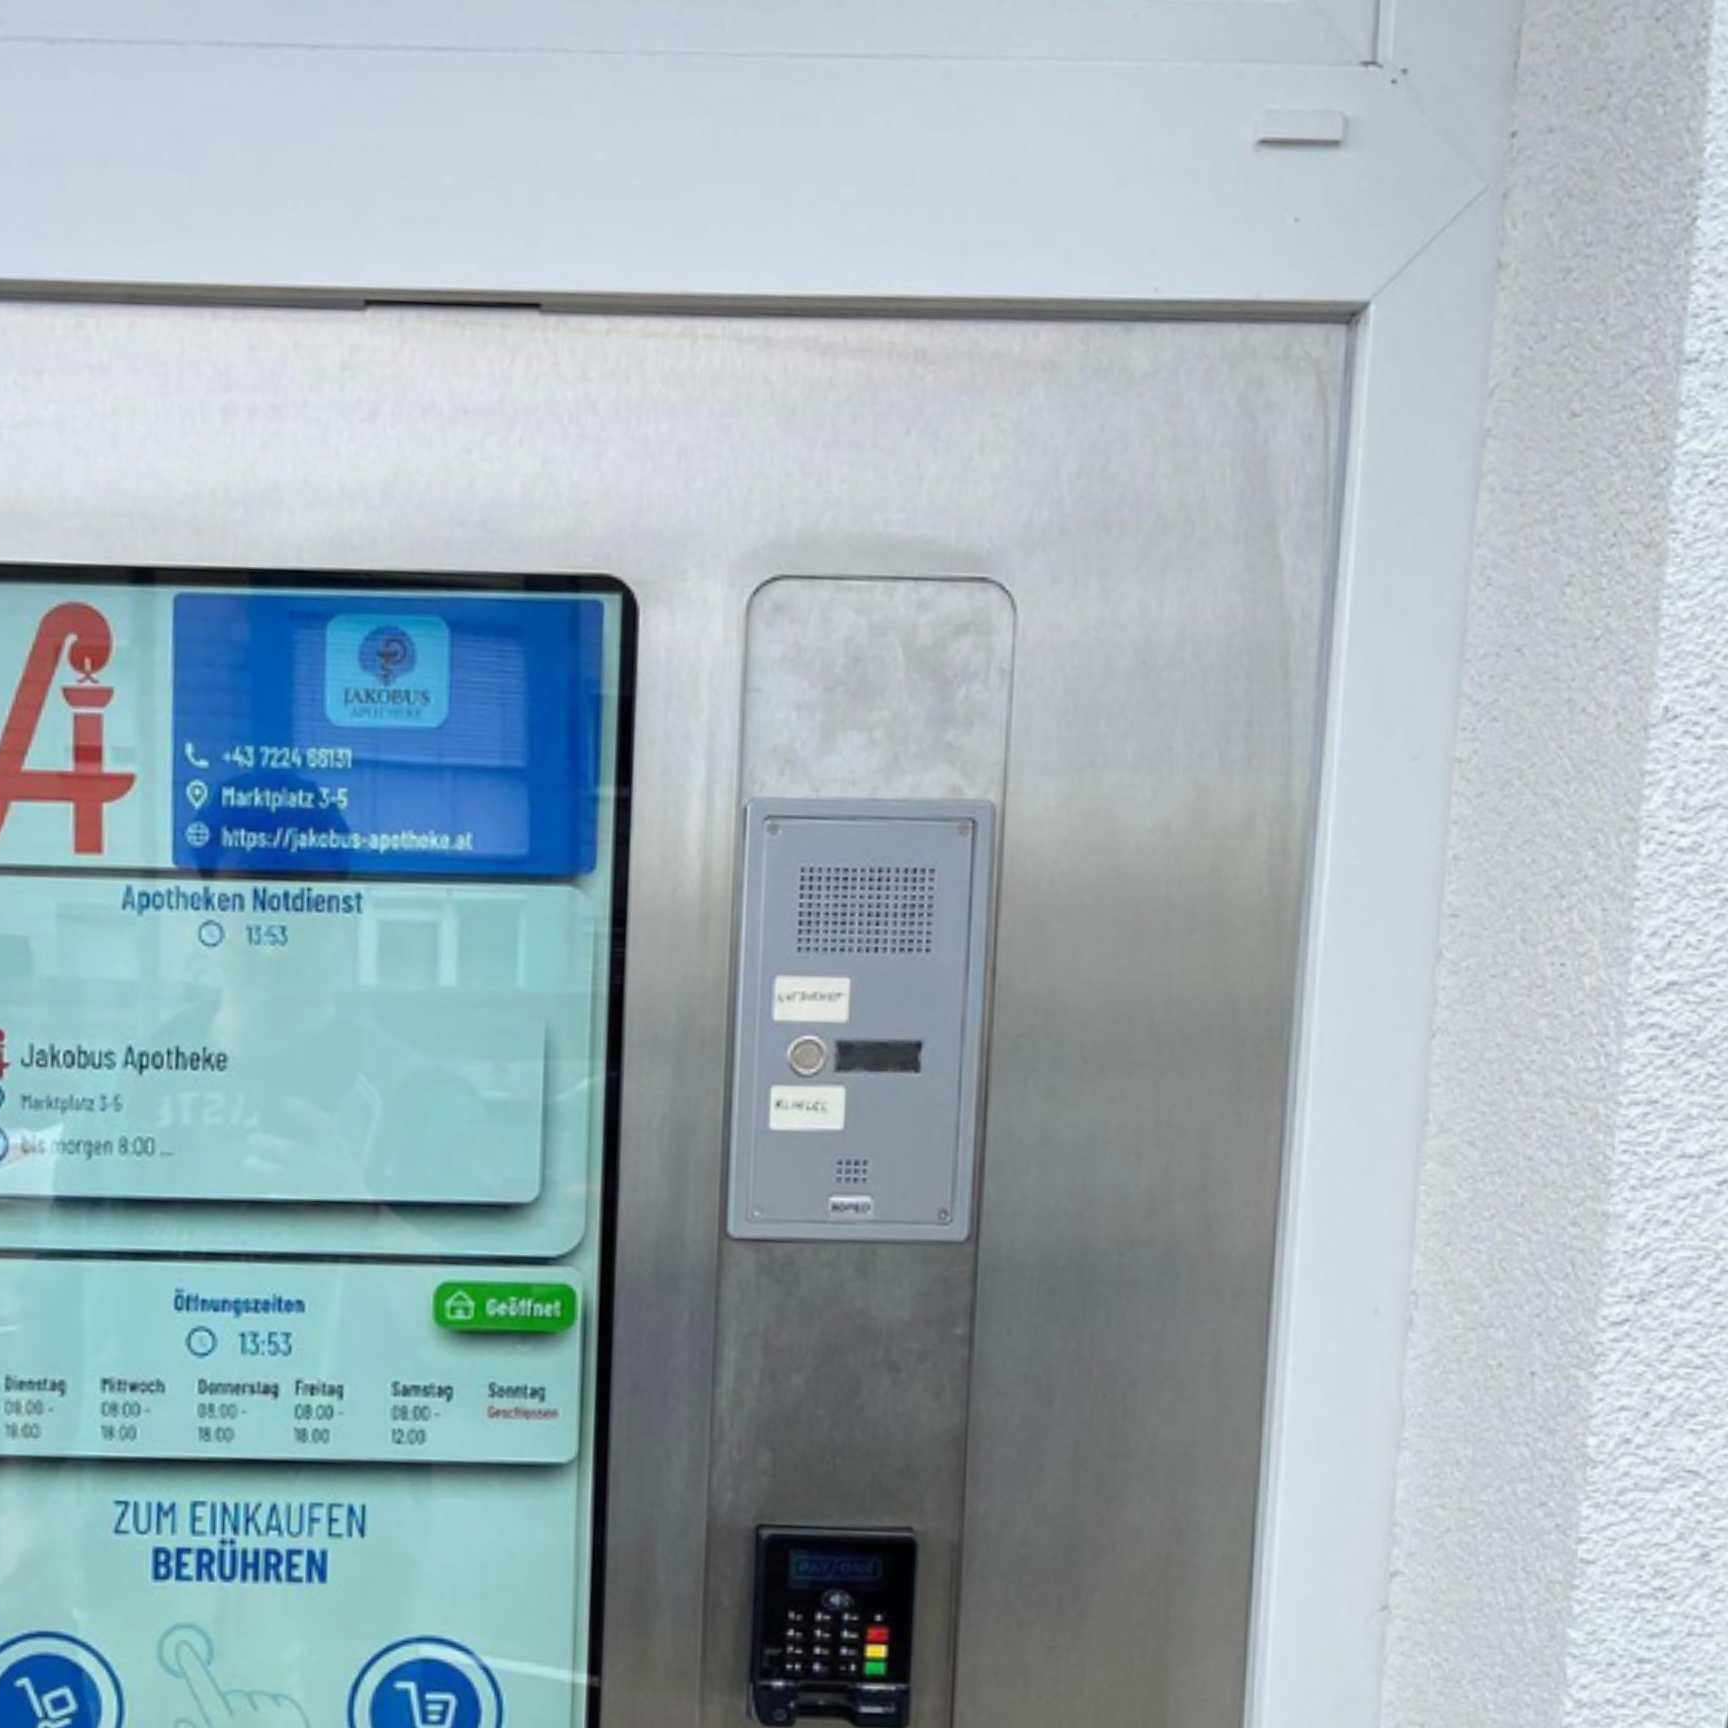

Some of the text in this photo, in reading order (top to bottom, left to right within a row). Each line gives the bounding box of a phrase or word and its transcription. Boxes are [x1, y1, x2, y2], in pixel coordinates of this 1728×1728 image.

[344, 687, 431, 707] JAKOBUS
[222, 745, 255, 769] +43
[259, 746, 302, 770] 7224
[221, 786, 349, 811] Marktplatz 3-5
[121, 884, 364, 916] Apotheken Notdienst
[246, 923, 289, 947] 13:53
[20, 1043, 229, 1075] Jakobus Apotheke
[20, 1095, 95, 1115] Marktplatz
[52, 1138, 113, 1160] morgen
[118, 1136, 156, 1157] 8:00
[173, 1289, 306, 1317] Öffnungszeiten
[485, 1297, 562, 1319] Geöffnet
[239, 1331, 294, 1357] 13:53
[4, 1375, 68, 1397] Dienstag
[100, 1376, 166, 1395] Mittwoch
[197, 1378, 279, 1400] Donnerstag
[294, 1379, 344, 1400] Freitag
[390, 1381, 454, 1402] Samstag
[487, 1382, 547, 1402] Sonntag
[113, 1500, 367, 1538] ZUM EINKAUFEN
[151, 1537, 329, 1584] BERÜHREN
